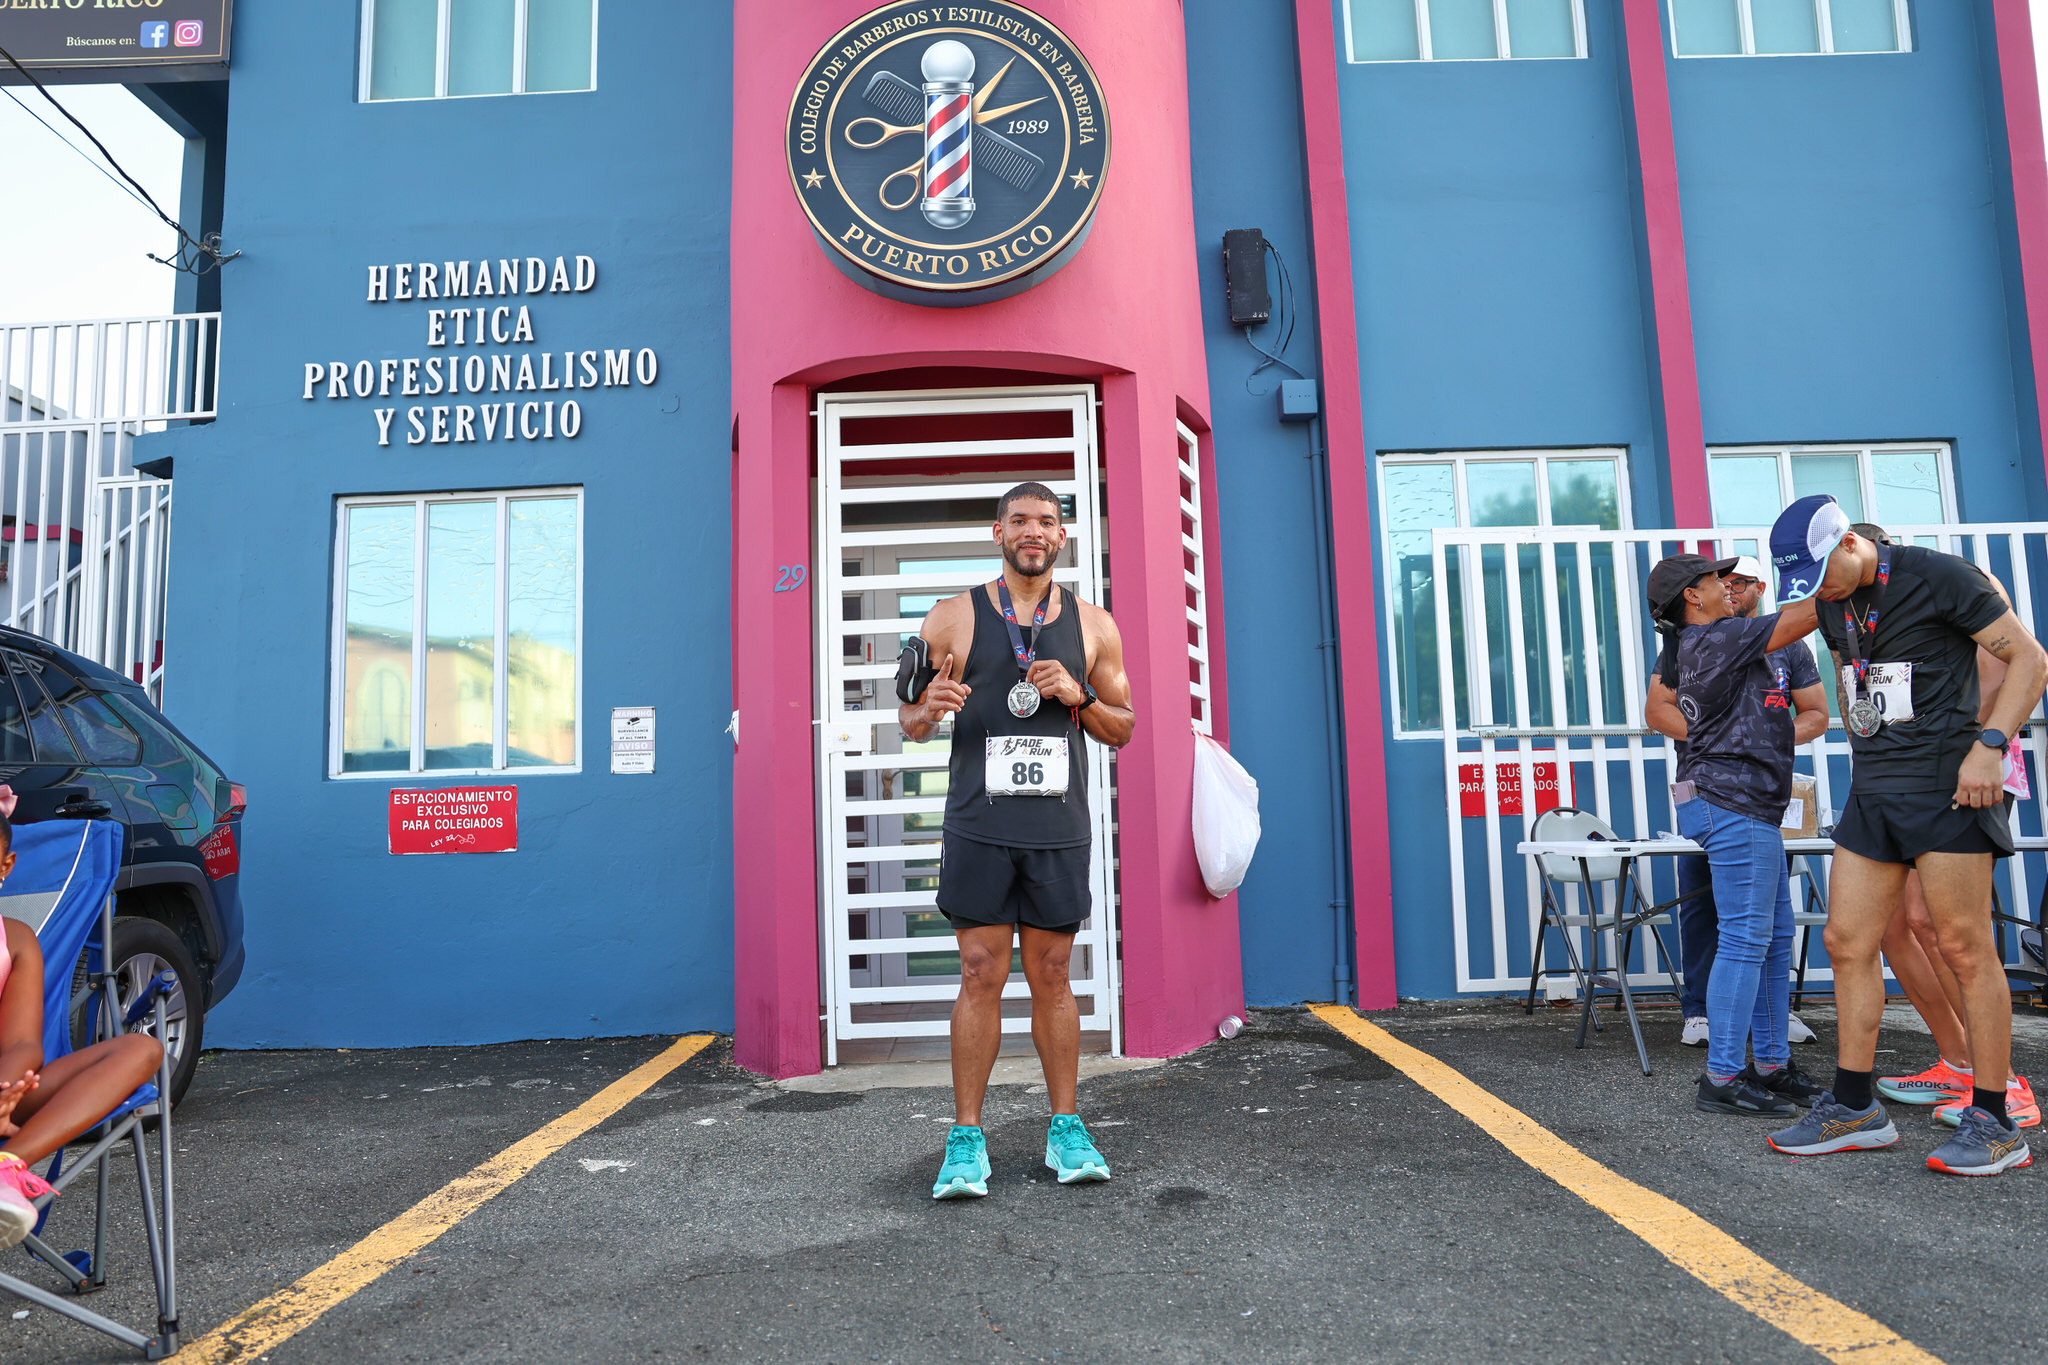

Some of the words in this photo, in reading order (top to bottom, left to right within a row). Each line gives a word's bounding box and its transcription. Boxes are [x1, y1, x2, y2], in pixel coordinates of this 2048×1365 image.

[66, 36, 116, 47] Búscanos
[119, 37, 136, 46] en:
[800, 81, 831, 154] COLEGIO
[822, 56, 847, 81] DE
[842, 8, 929, 62] BARBEROS
[934, 8, 943, 22] Y
[948, 7, 1041, 47] ESTILISTAS
[1037, 40, 1061, 65] EN
[1056, 60, 1098, 146] BARBERÍA
[1006, 119, 1049, 135] 1989
[840, 222, 969, 276] PUERTO
[977, 224, 1053, 272] RICO
[367, 255, 597, 301] HERMANDAD
[427, 304, 535, 346] ETICA
[302, 347, 658, 400] PROFESIONALISMO
[374, 408, 396, 446] Y
[407, 400, 582, 444] SERVICIO
[774, 564, 807, 593] 29
[1872, 675, 1893, 685] RUN
[618, 742, 648, 750] AVISO
[1015, 738, 1044, 748] FADE
[1029, 747, 1053, 756] RUN
[1011, 761, 1044, 786] 86
[393, 790, 513, 805] ESTACIONAMIENTO
[417, 804, 489, 817] EXCLUSIVO
[402, 820, 430, 831] PARA
[434, 817, 504, 830] COLEGIADOS
[430, 838, 443, 848] LEY
[1898, 1081, 1951, 1090] BROOKS
